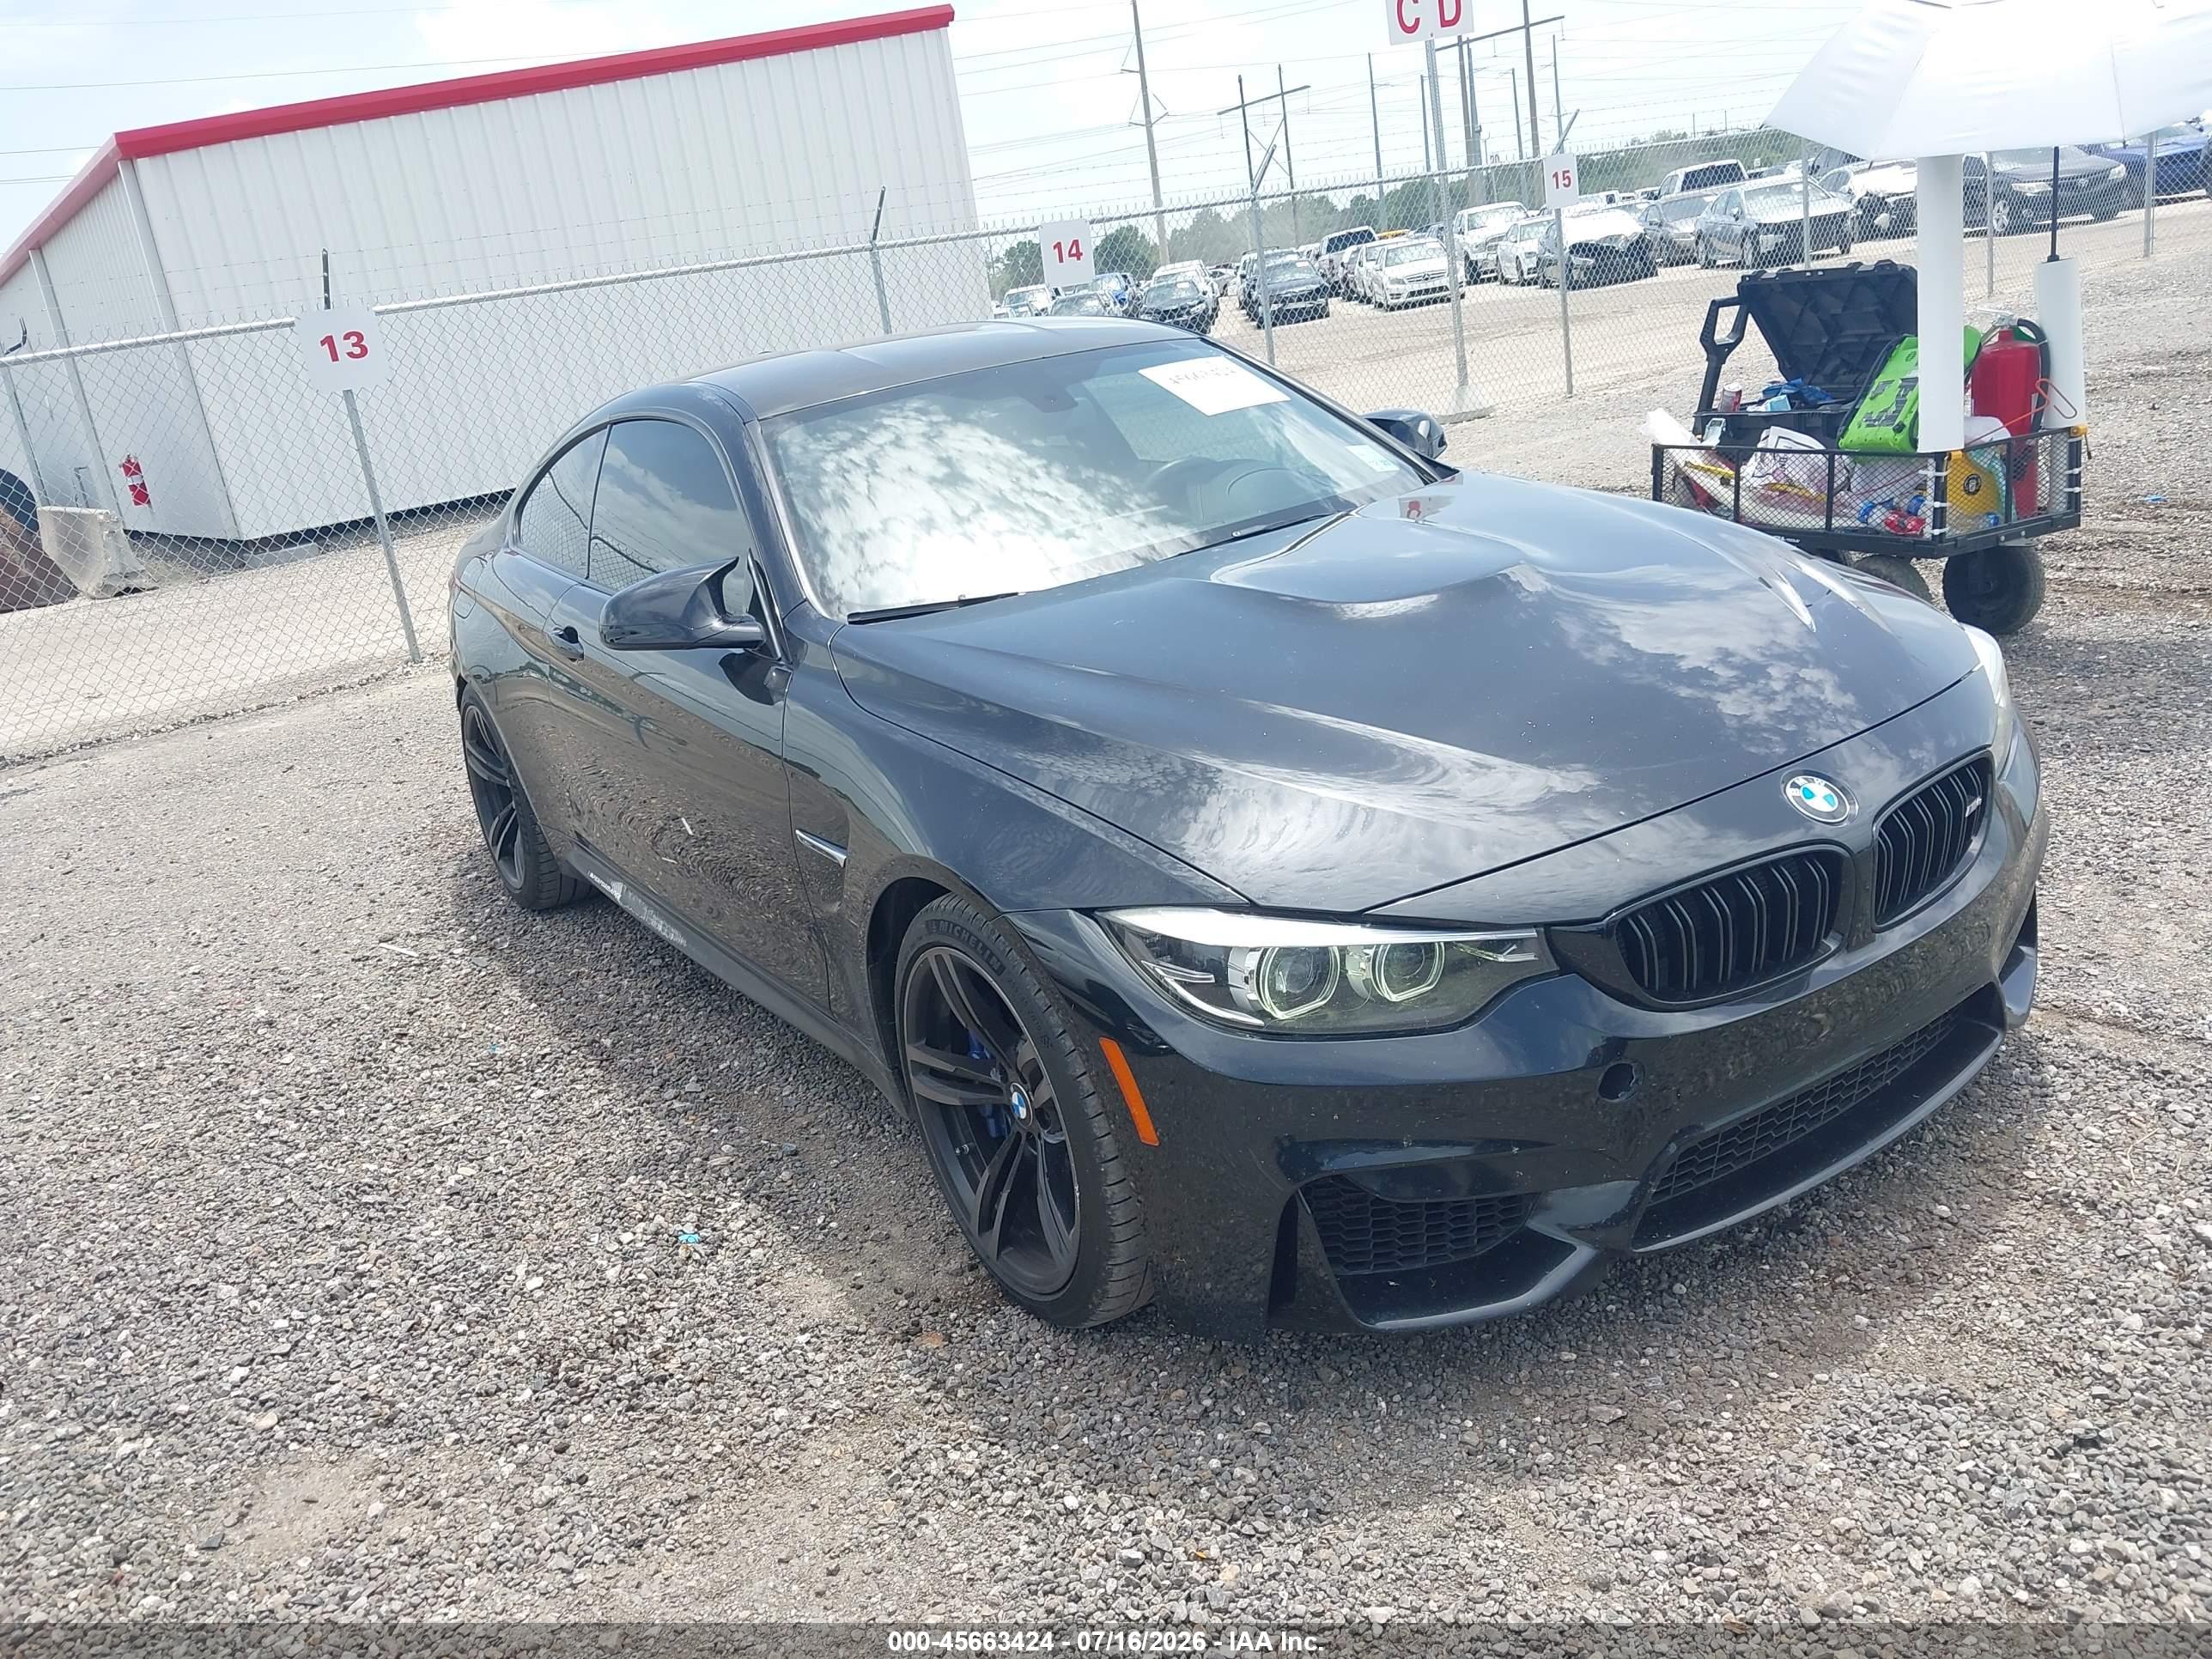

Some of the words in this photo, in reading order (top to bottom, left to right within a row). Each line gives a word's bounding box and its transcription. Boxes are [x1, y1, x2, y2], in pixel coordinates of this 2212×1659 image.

[1396, 0, 1420, 33] C
[1438, 0, 1462, 27] D
[1552, 170, 1571, 190] 15
[1053, 239, 1083, 264] 14
[319, 331, 368, 362] 13
[939, 920, 1002, 971] MICHELIN
